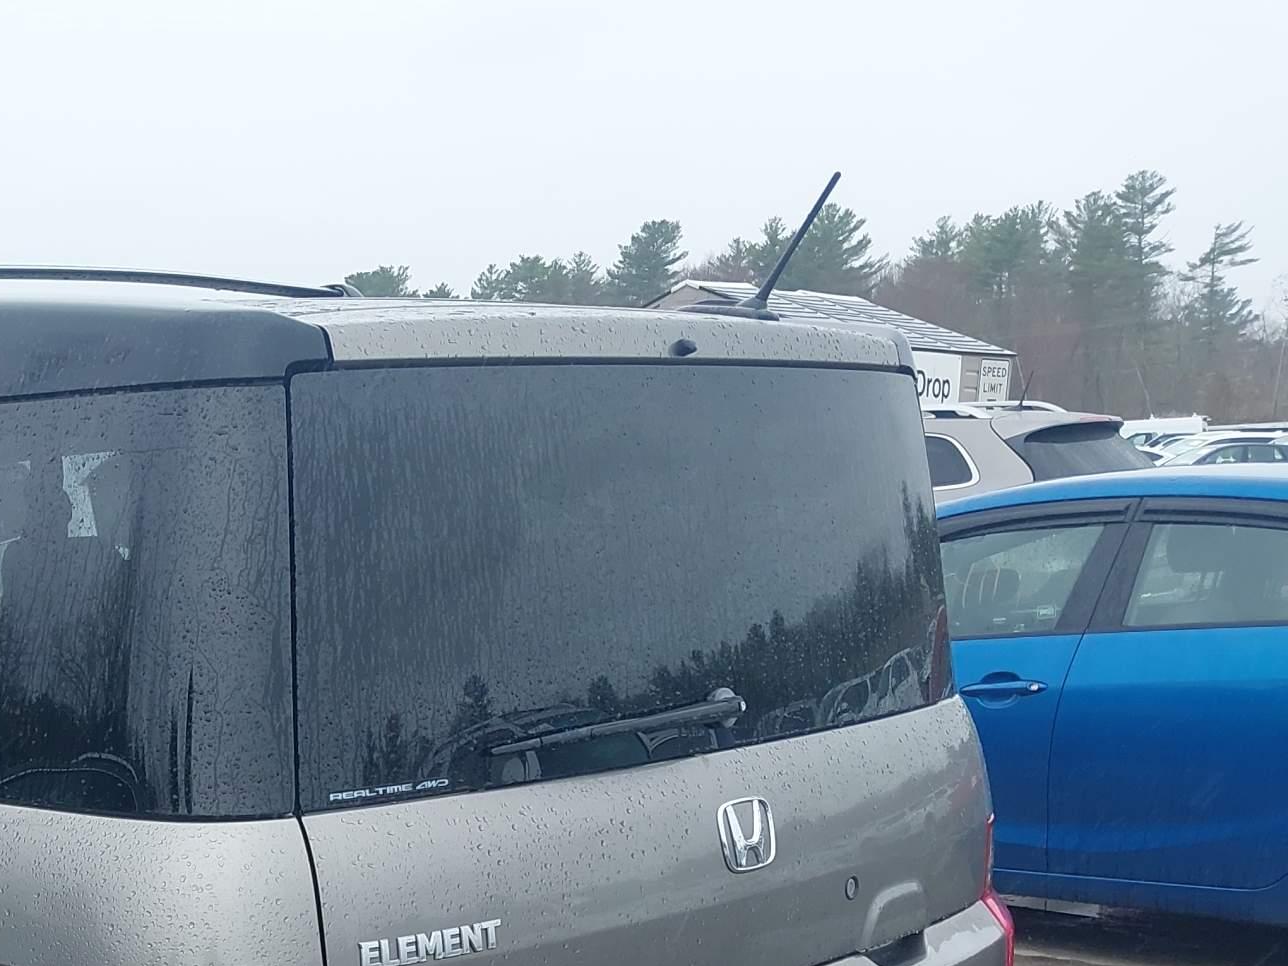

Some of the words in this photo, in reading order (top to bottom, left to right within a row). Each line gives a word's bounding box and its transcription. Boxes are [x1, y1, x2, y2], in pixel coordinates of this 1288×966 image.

[982, 366, 1007, 378] SPEED
[916, 369, 951, 404] Drop
[983, 383, 1003, 394] LIMIT
[329, 783, 413, 801] REALTIME
